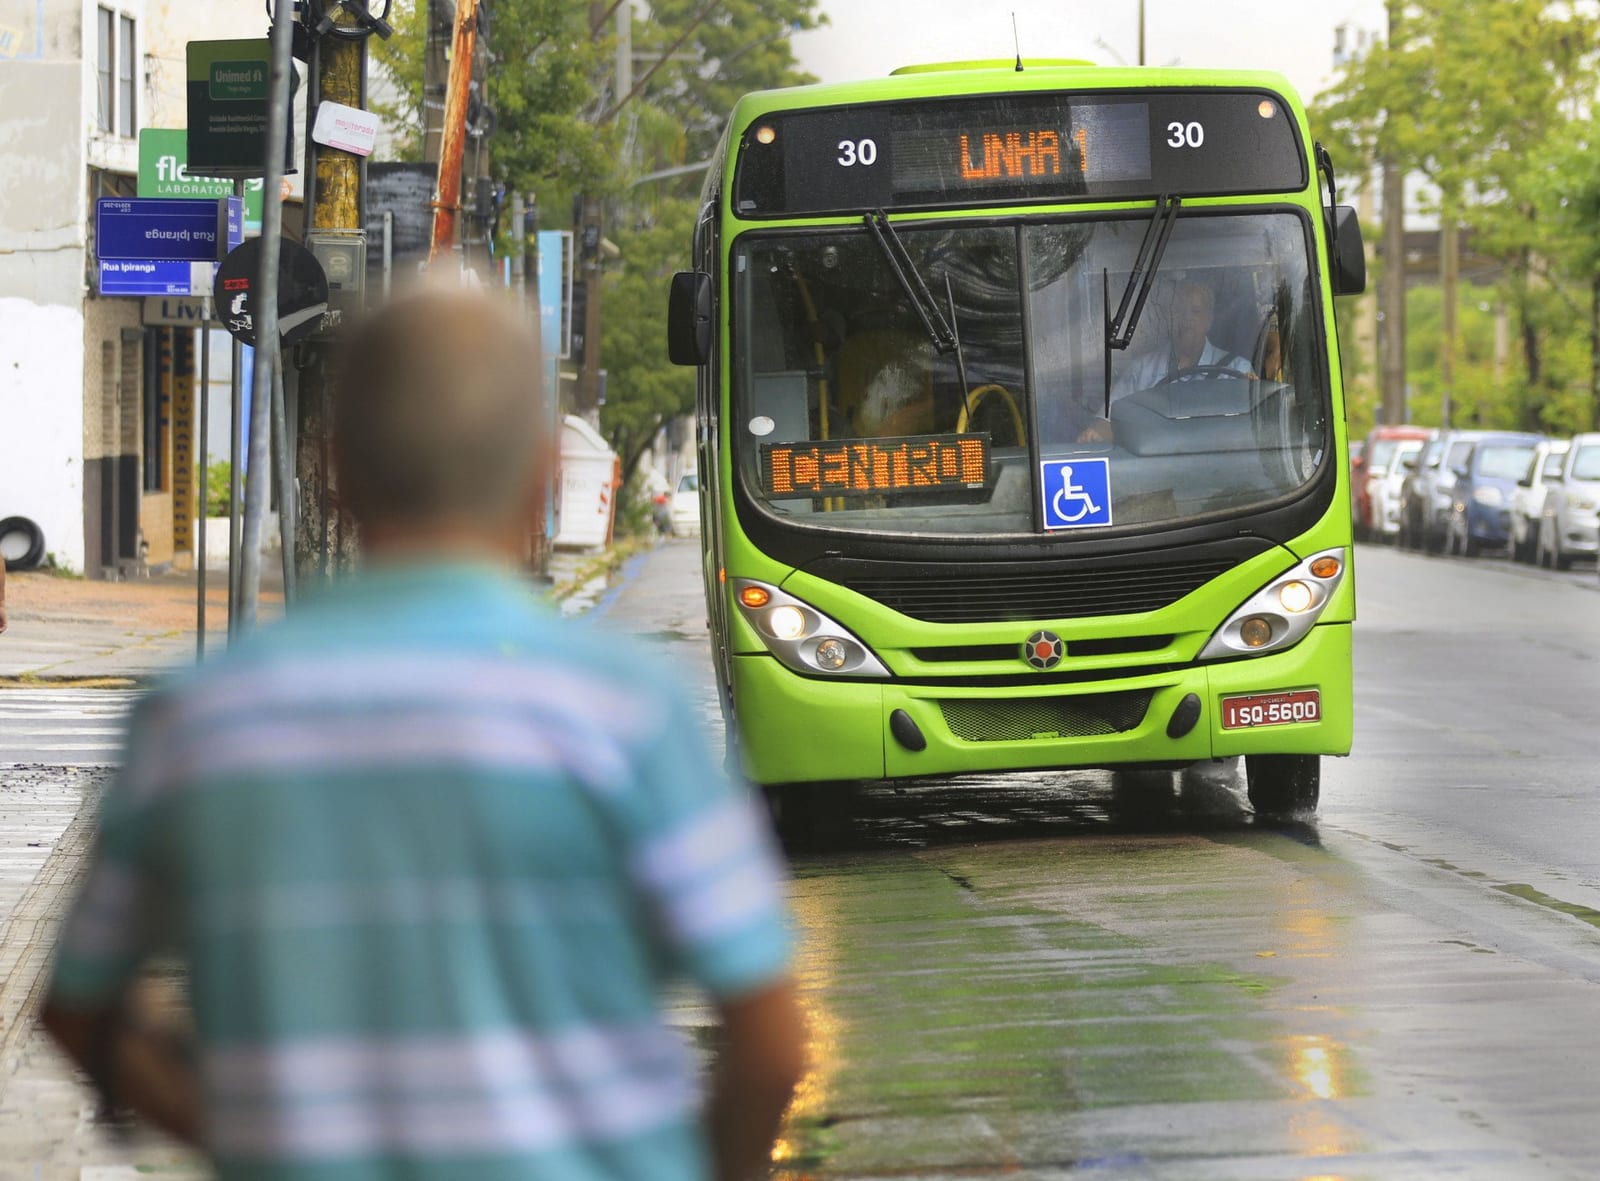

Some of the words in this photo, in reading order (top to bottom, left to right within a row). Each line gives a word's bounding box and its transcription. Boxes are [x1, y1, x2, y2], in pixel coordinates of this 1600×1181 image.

[215, 69, 251, 83] Unimed
[1167, 122, 1204, 148] 30
[838, 139, 877, 166] 30
[960, 130, 1060, 179] LINHA
[1073, 128, 1088, 172] 1
[145, 229, 190, 242] Ipiranga
[193, 231, 215, 242] Rua
[102, 262, 119, 271] Rua
[121, 263, 156, 273] Ipiranga
[785, 442, 965, 490] CENTRO
